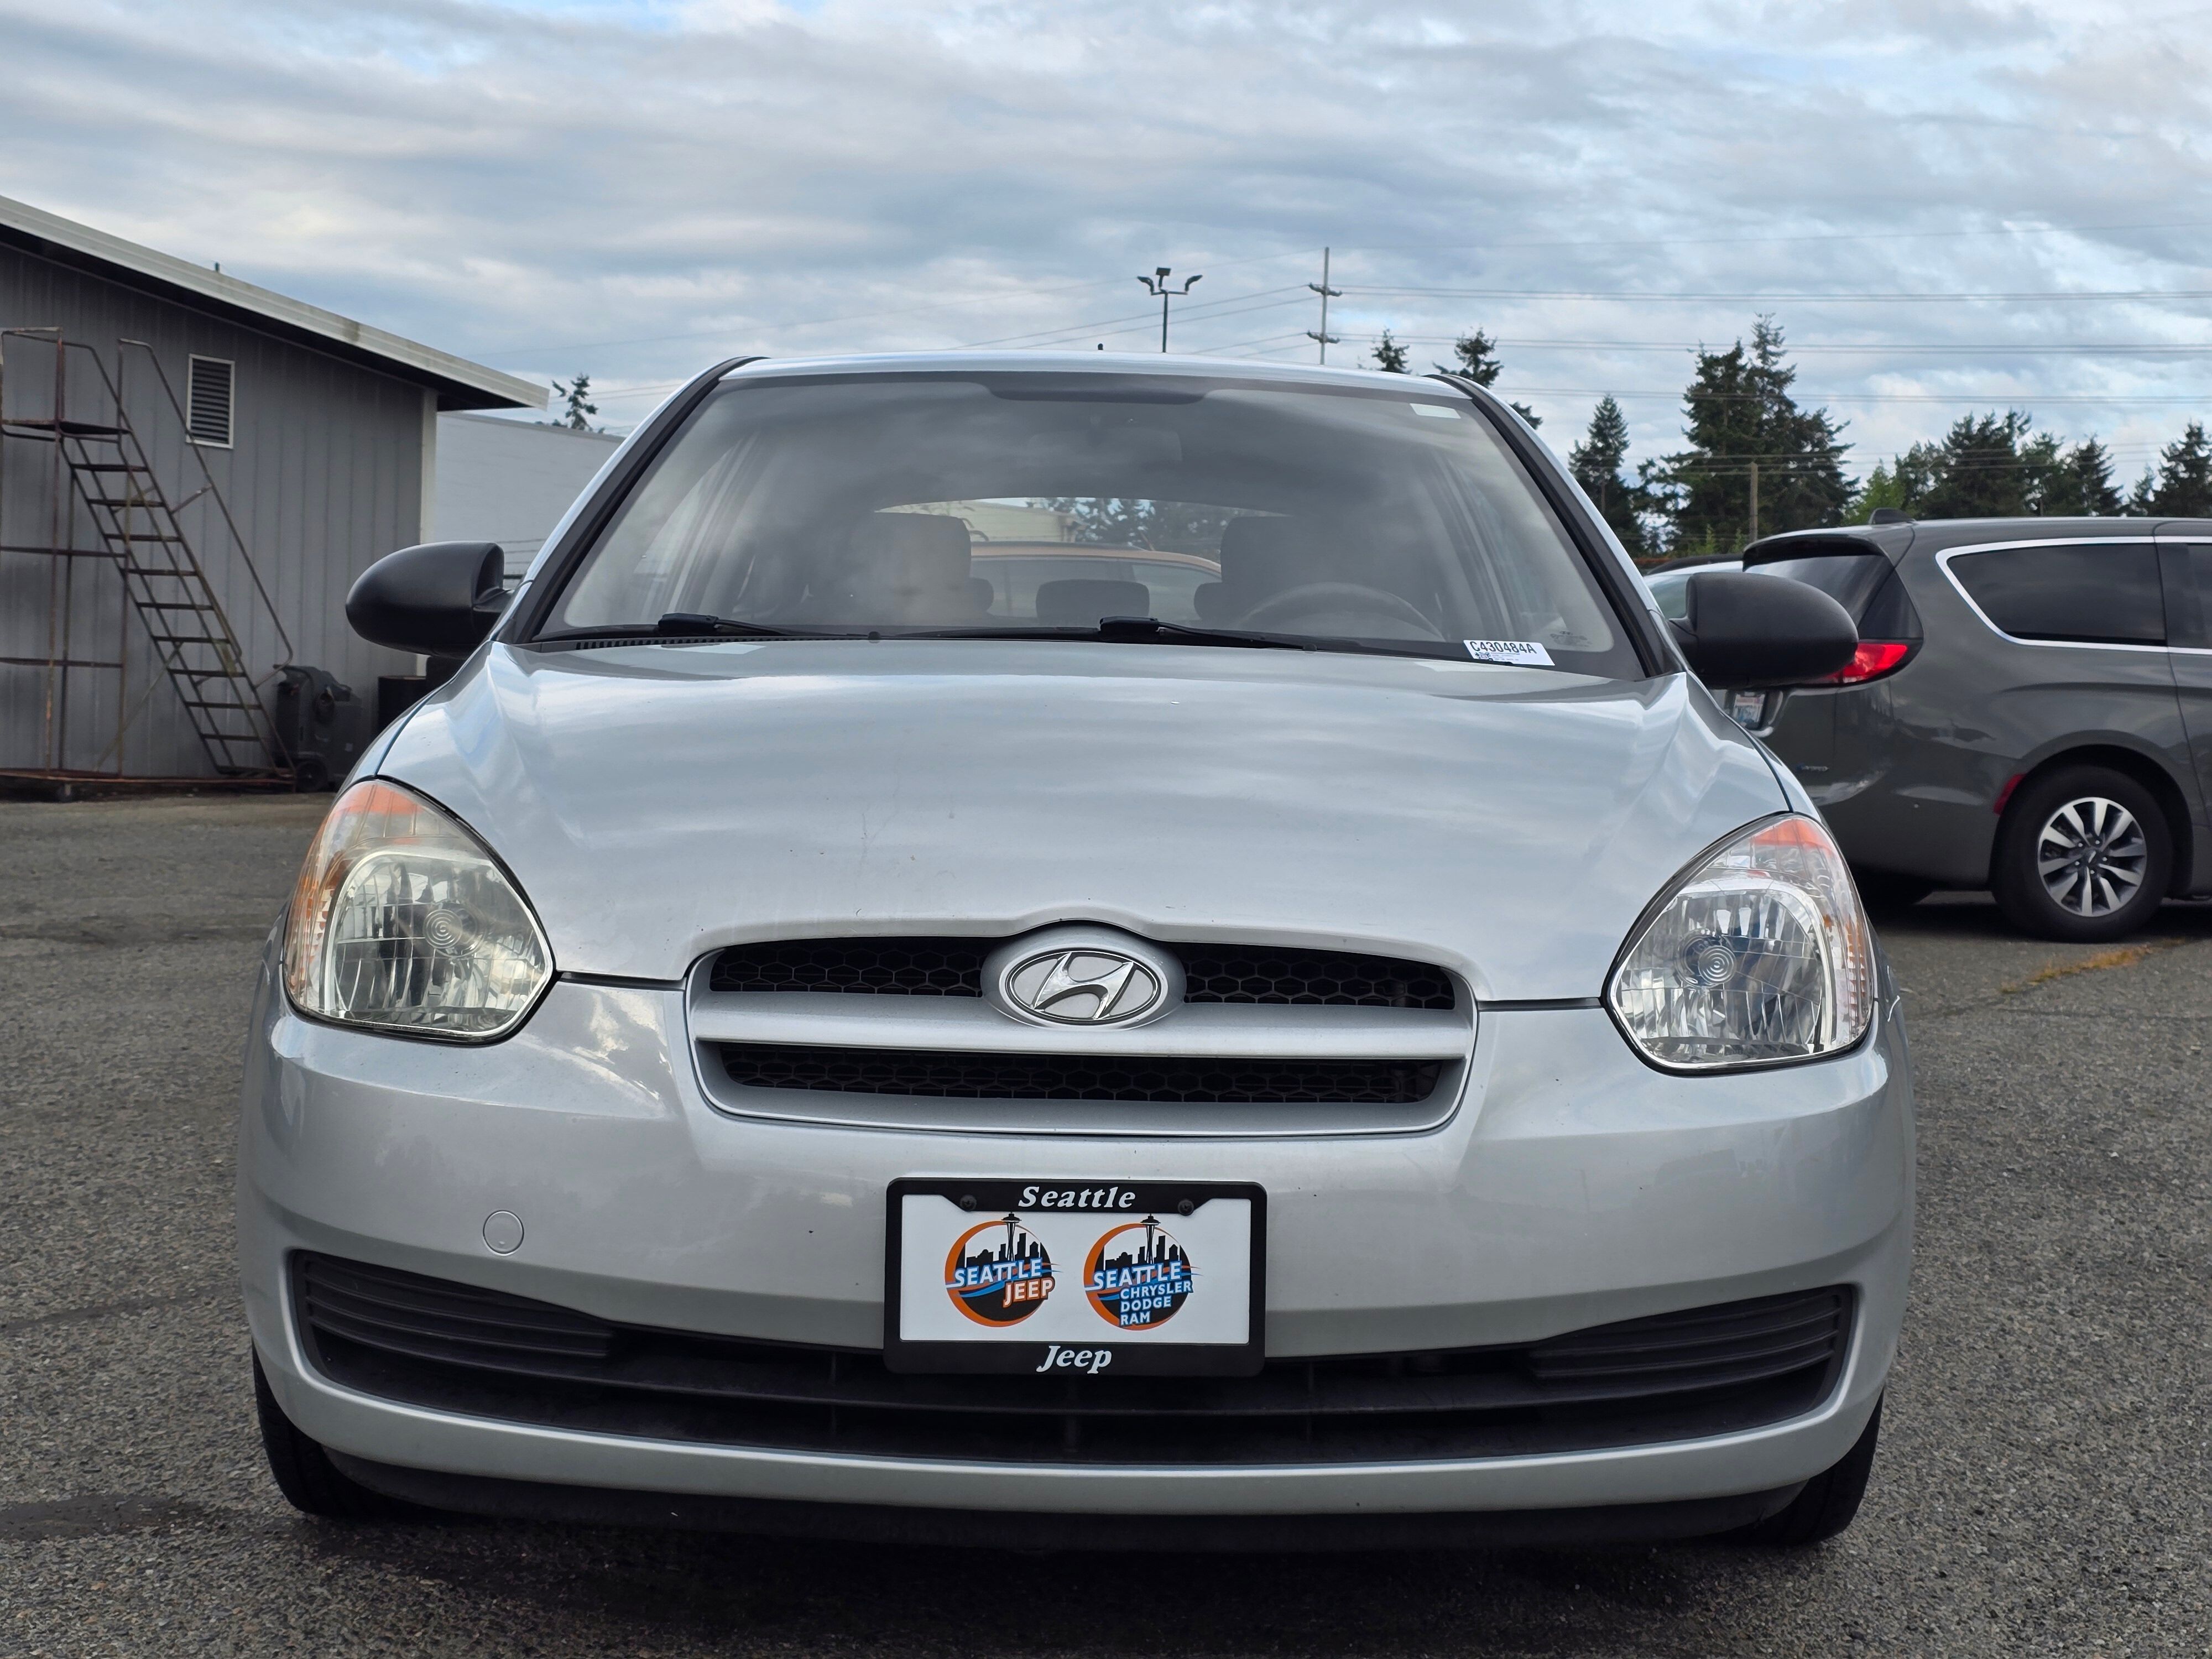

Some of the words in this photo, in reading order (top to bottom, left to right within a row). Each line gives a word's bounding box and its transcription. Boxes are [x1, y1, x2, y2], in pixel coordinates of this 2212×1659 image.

[1469, 641, 1537, 654] C430484A
[1018, 1186, 1136, 1208] Seattle
[946, 1259, 1042, 1288] SEATTLE
[1084, 1262, 1181, 1290] SEATTLE
[1004, 1279, 1053, 1306] JEEP
[1120, 1281, 1192, 1300] CHRYSLER
[1120, 1295, 1171, 1313] DODGE
[1120, 1311, 1150, 1326] RAM
[1036, 1345, 1112, 1374] Jeep
